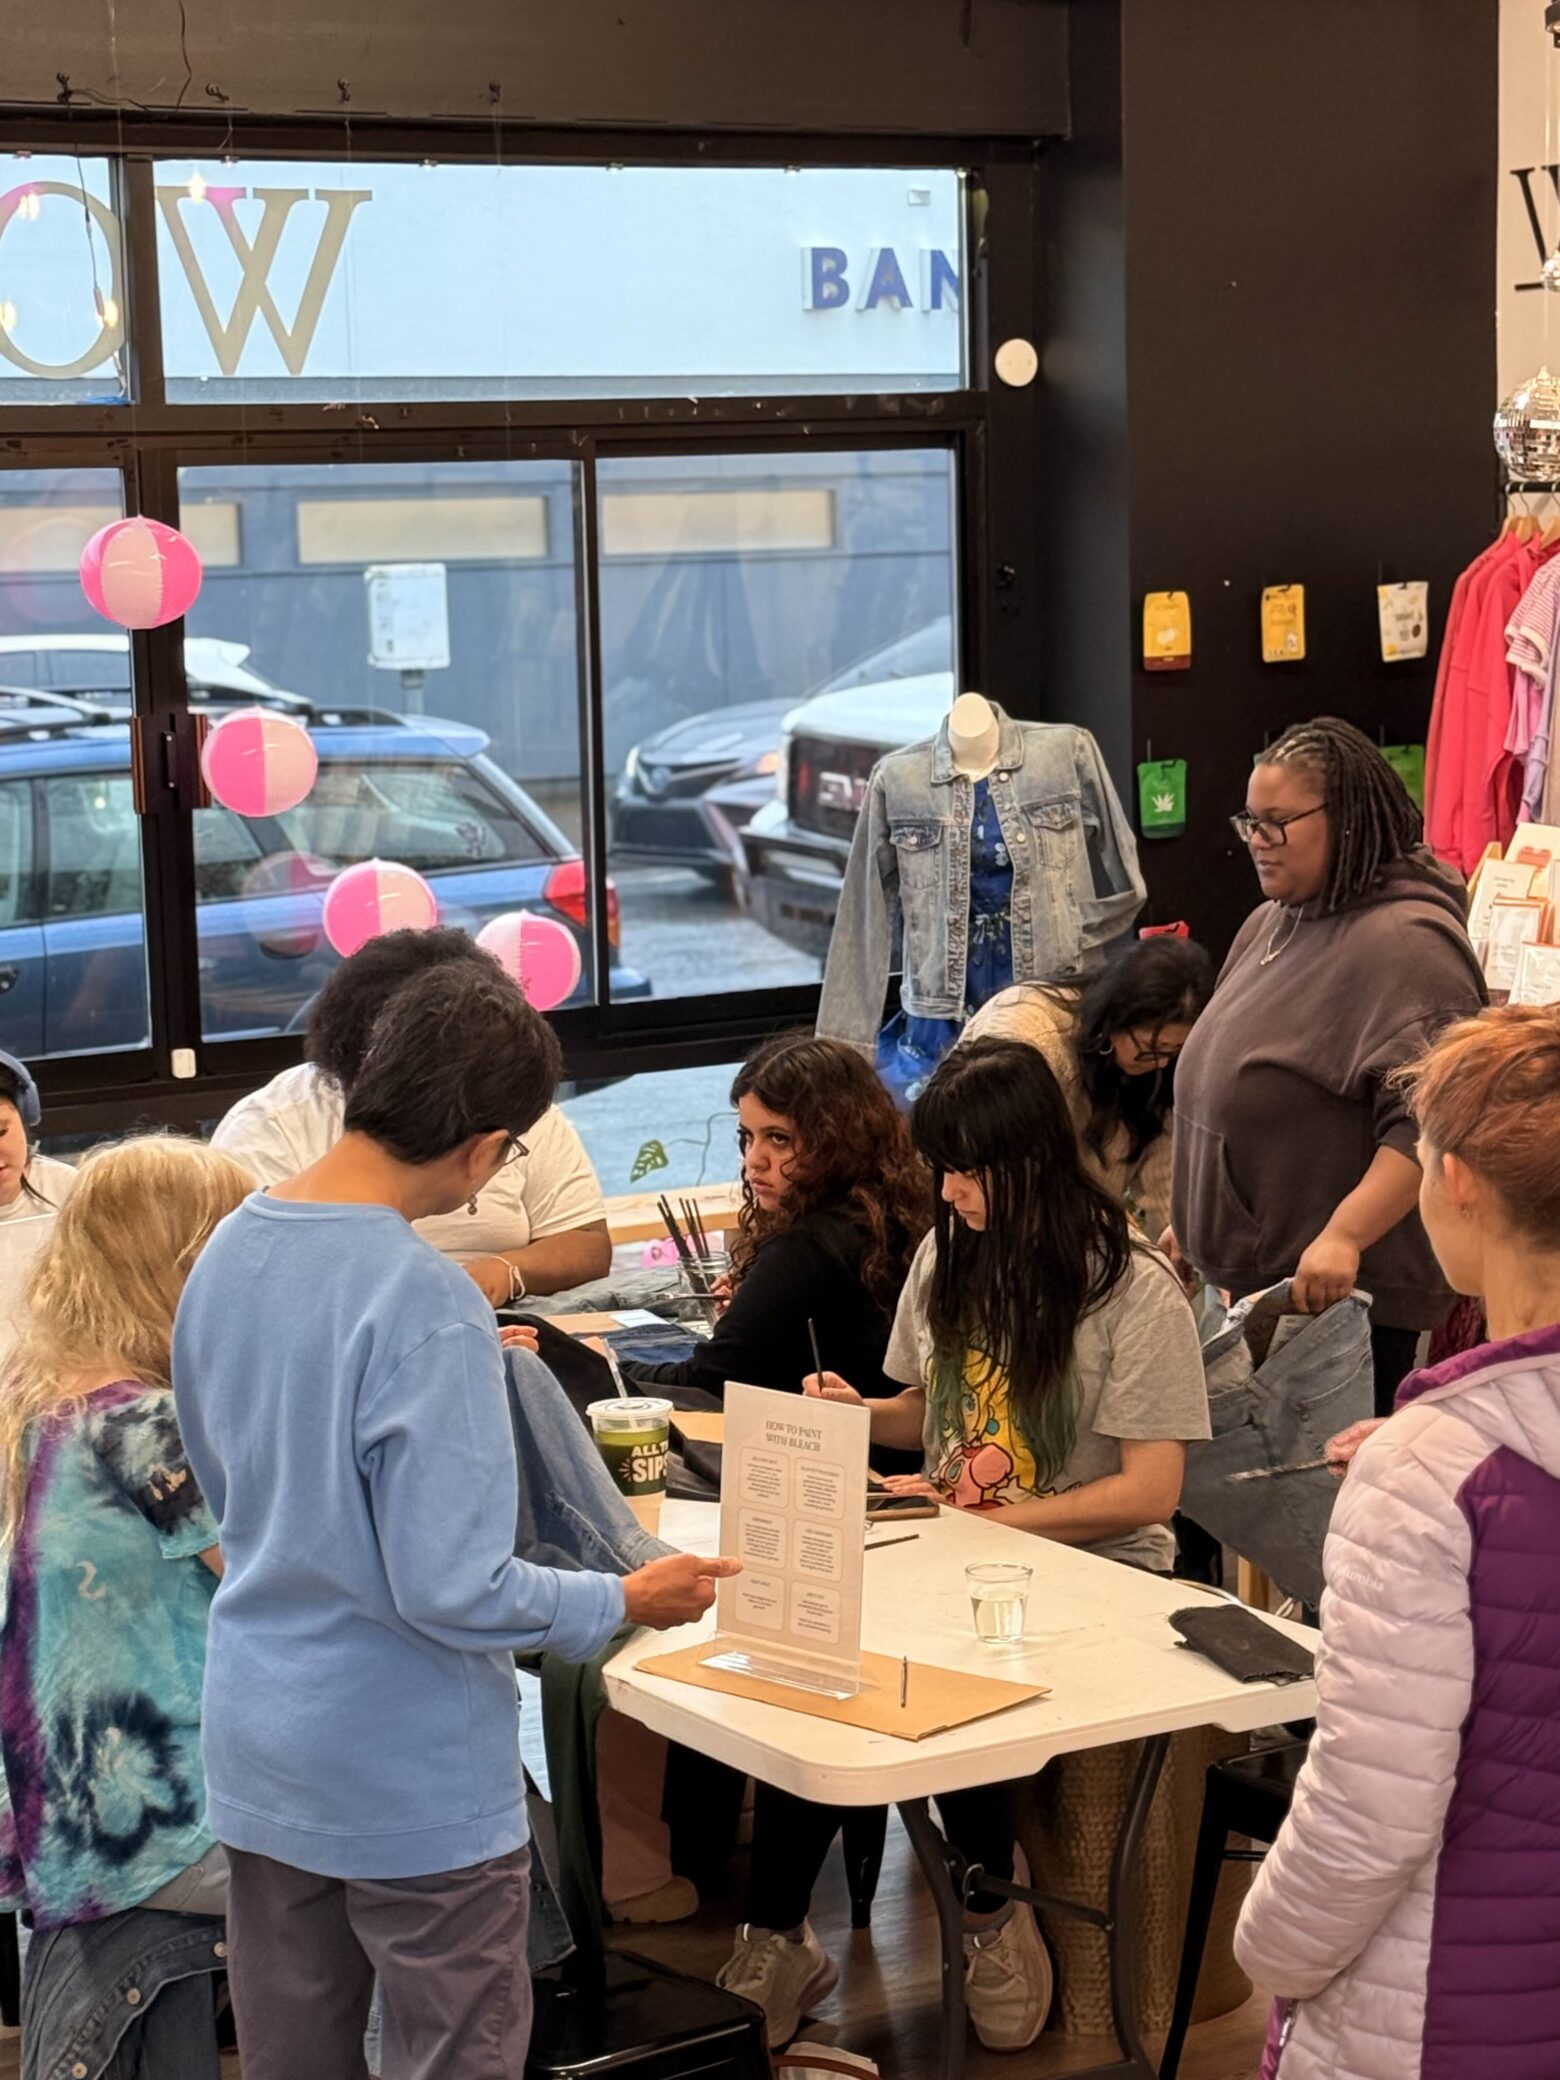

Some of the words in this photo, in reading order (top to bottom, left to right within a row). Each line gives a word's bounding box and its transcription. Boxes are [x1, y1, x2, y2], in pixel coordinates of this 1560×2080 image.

[765, 1420, 784, 1431] HOW
[786, 1423, 798, 1434] TO
[798, 1426, 822, 1440] PAINT
[631, 1443, 660, 1457] ALL
[766, 1433, 788, 1447] WITH
[789, 1437, 821, 1452] BLEACH
